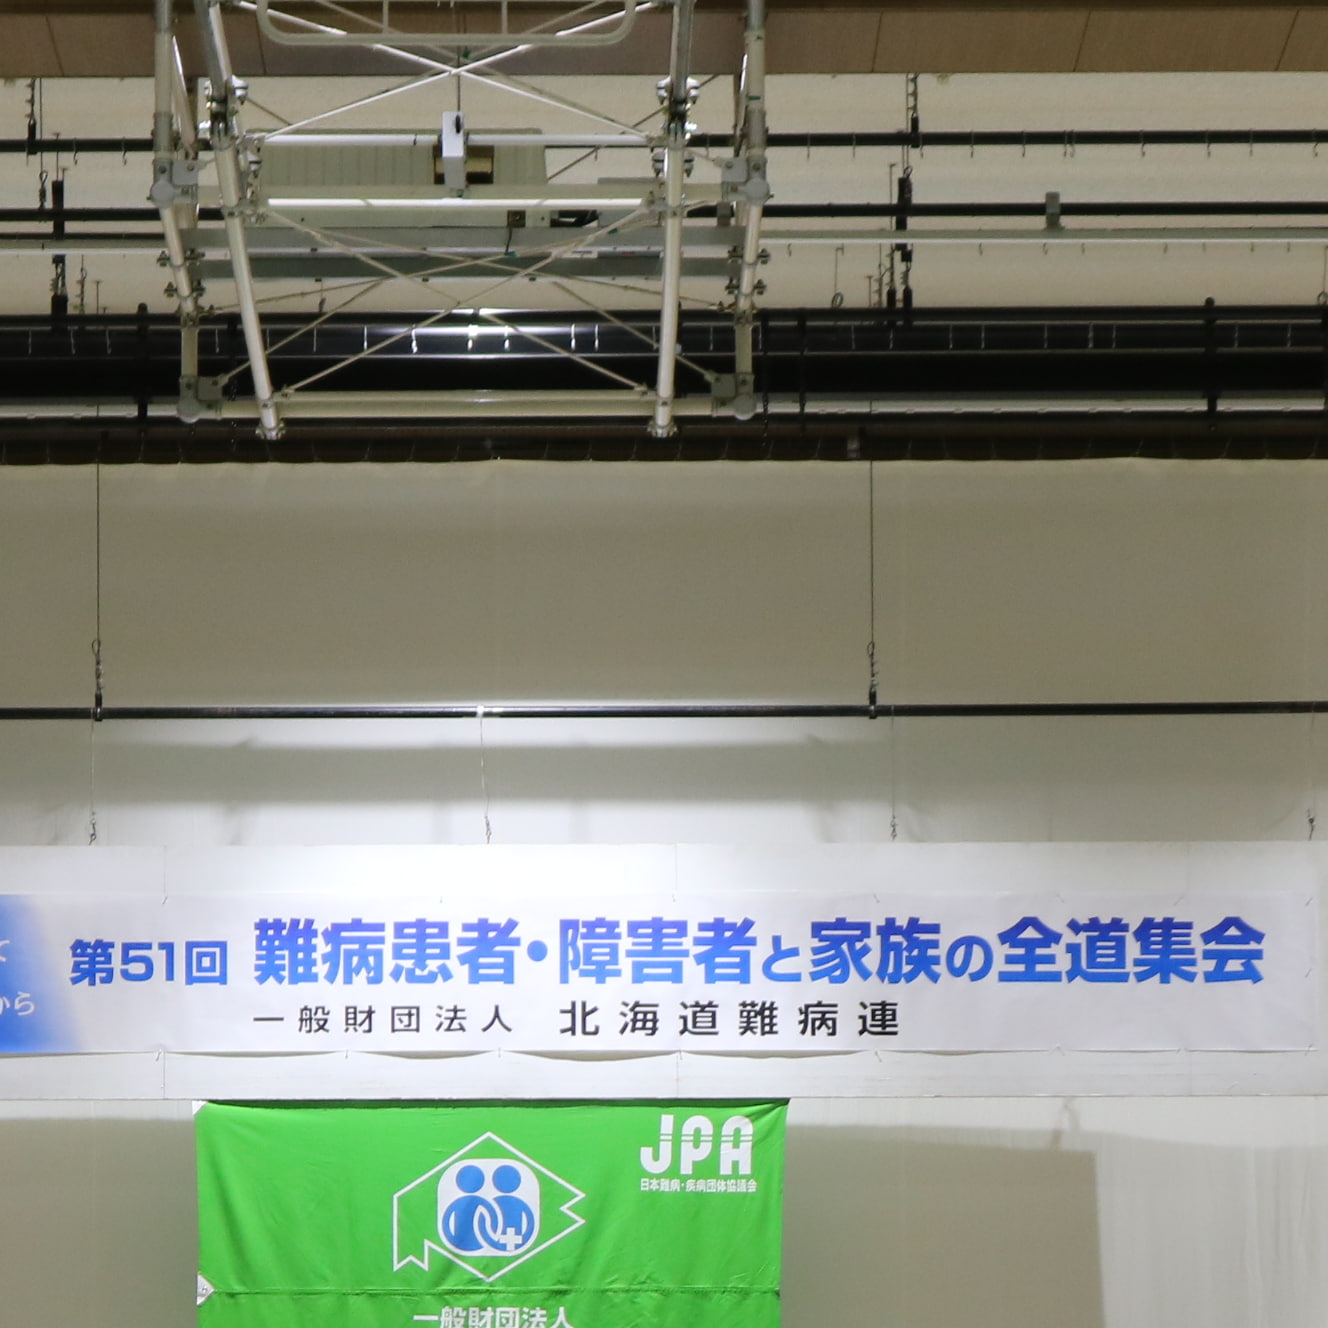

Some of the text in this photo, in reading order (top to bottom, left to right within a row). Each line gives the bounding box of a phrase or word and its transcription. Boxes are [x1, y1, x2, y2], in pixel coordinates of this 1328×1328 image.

[69, 916, 1266, 987] 第51回 難病患者・障害者と家族の全道集会
[254, 1000, 900, 1036] 一般財団法人 北海道難病連
[640, 1114, 754, 1175] JPA
